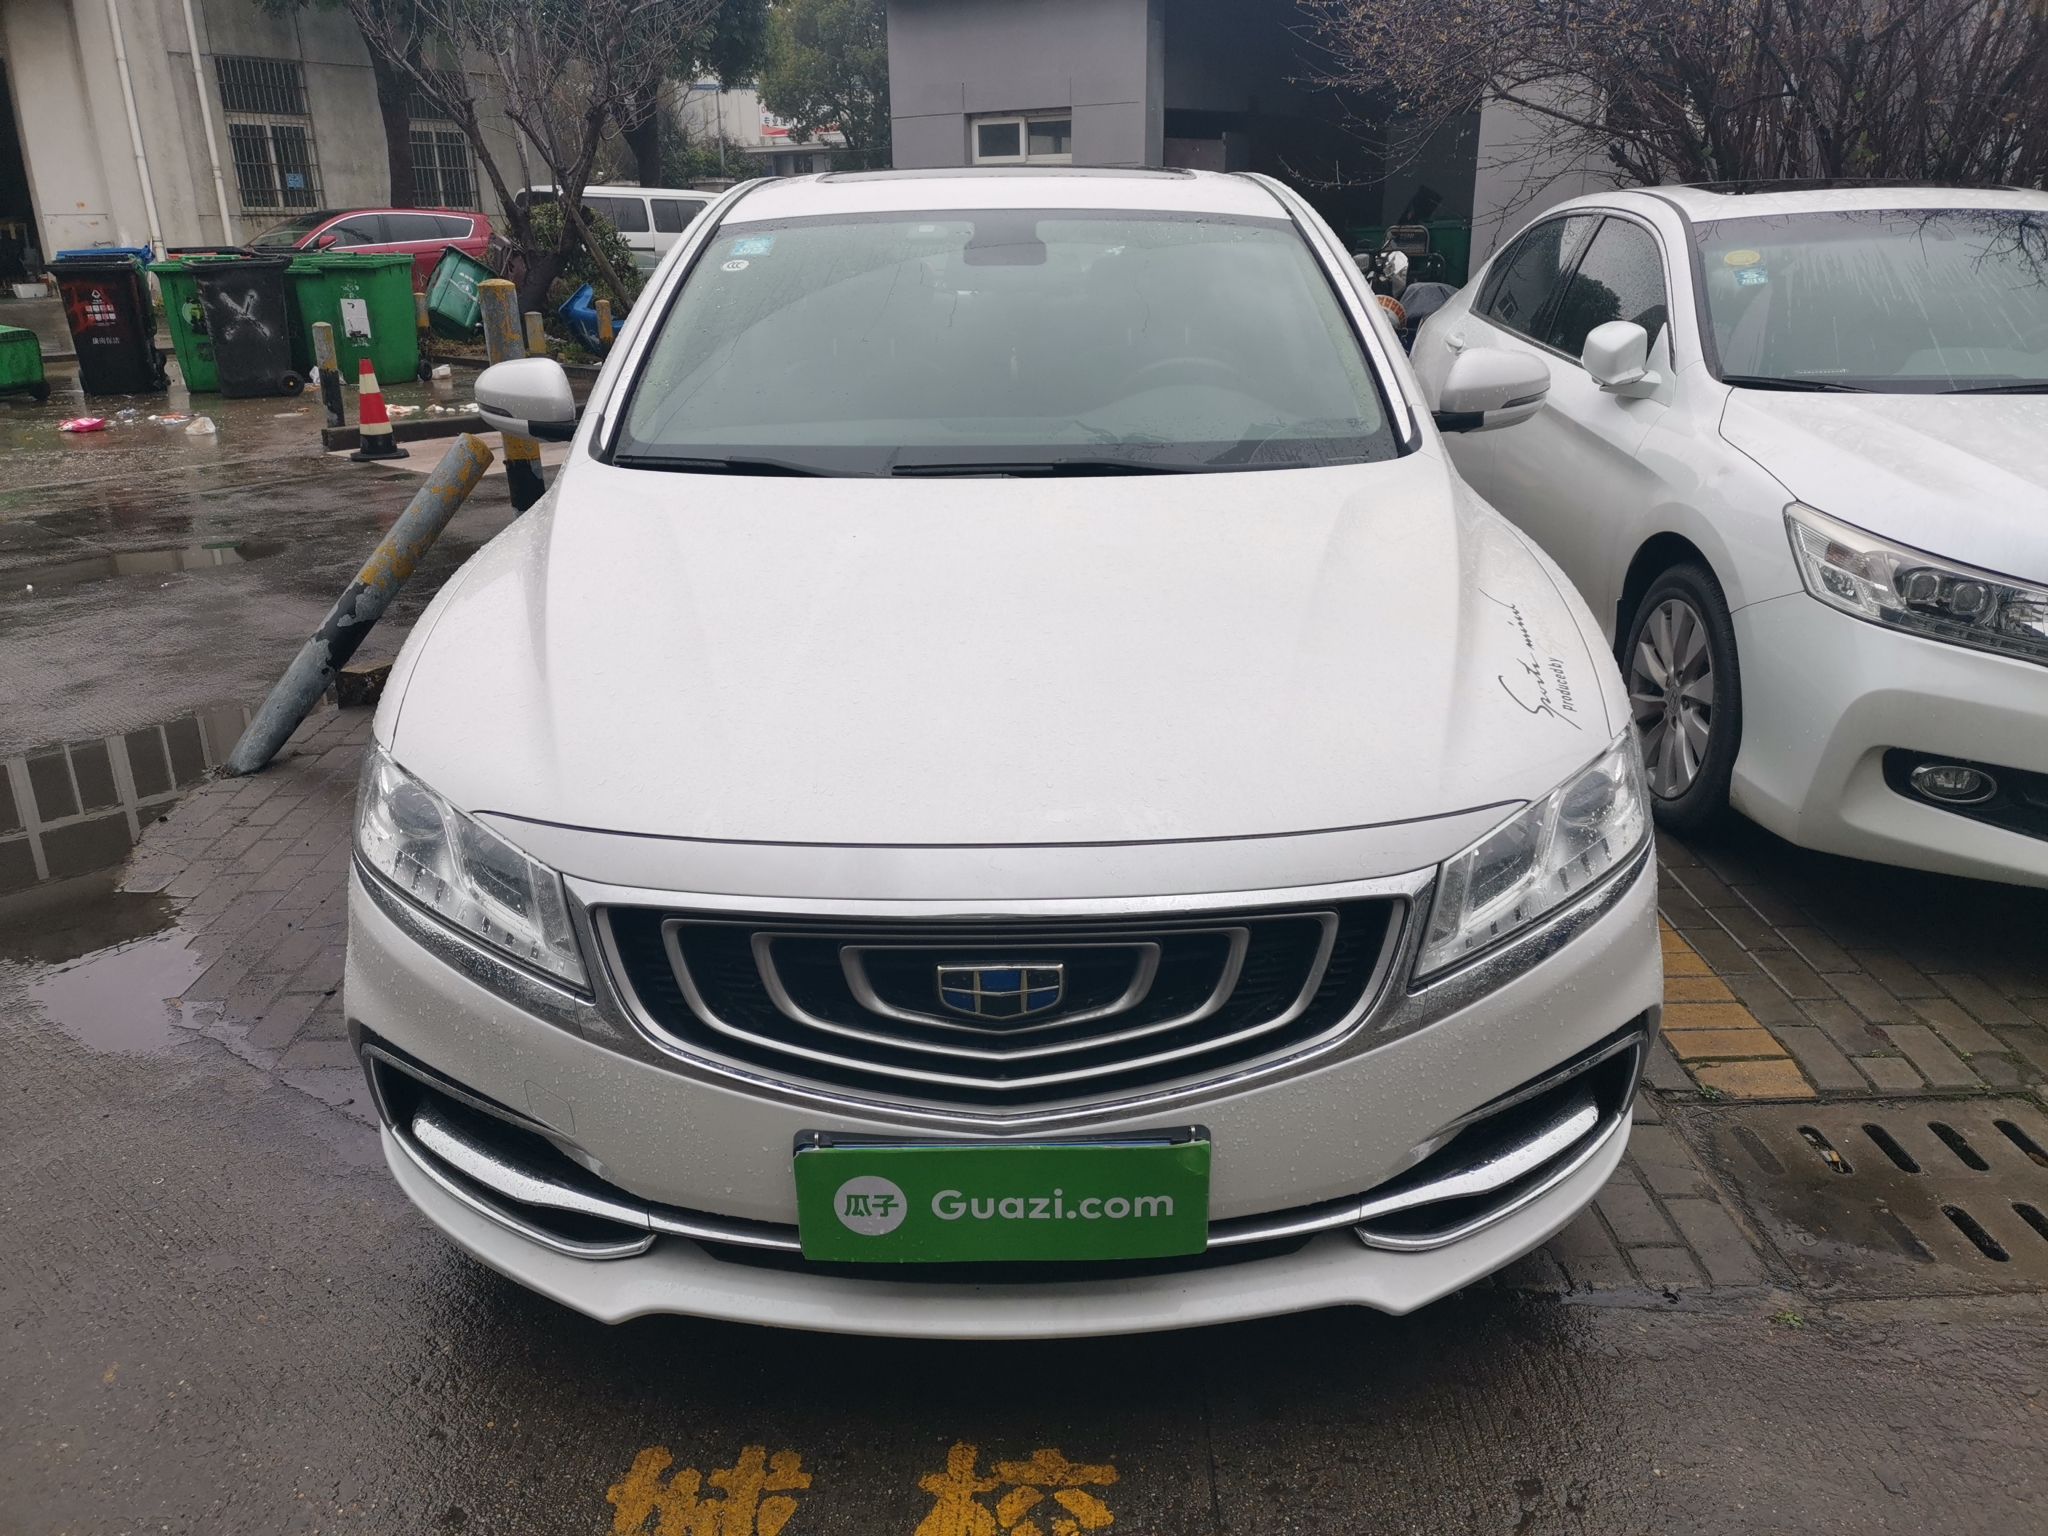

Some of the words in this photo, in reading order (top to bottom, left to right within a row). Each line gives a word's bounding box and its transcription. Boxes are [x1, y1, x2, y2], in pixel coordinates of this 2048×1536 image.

[1478, 588, 1535, 651] mind
[843, 1193, 900, 1219] 瓜子
[930, 1187, 1175, 1221] Guazi.com
